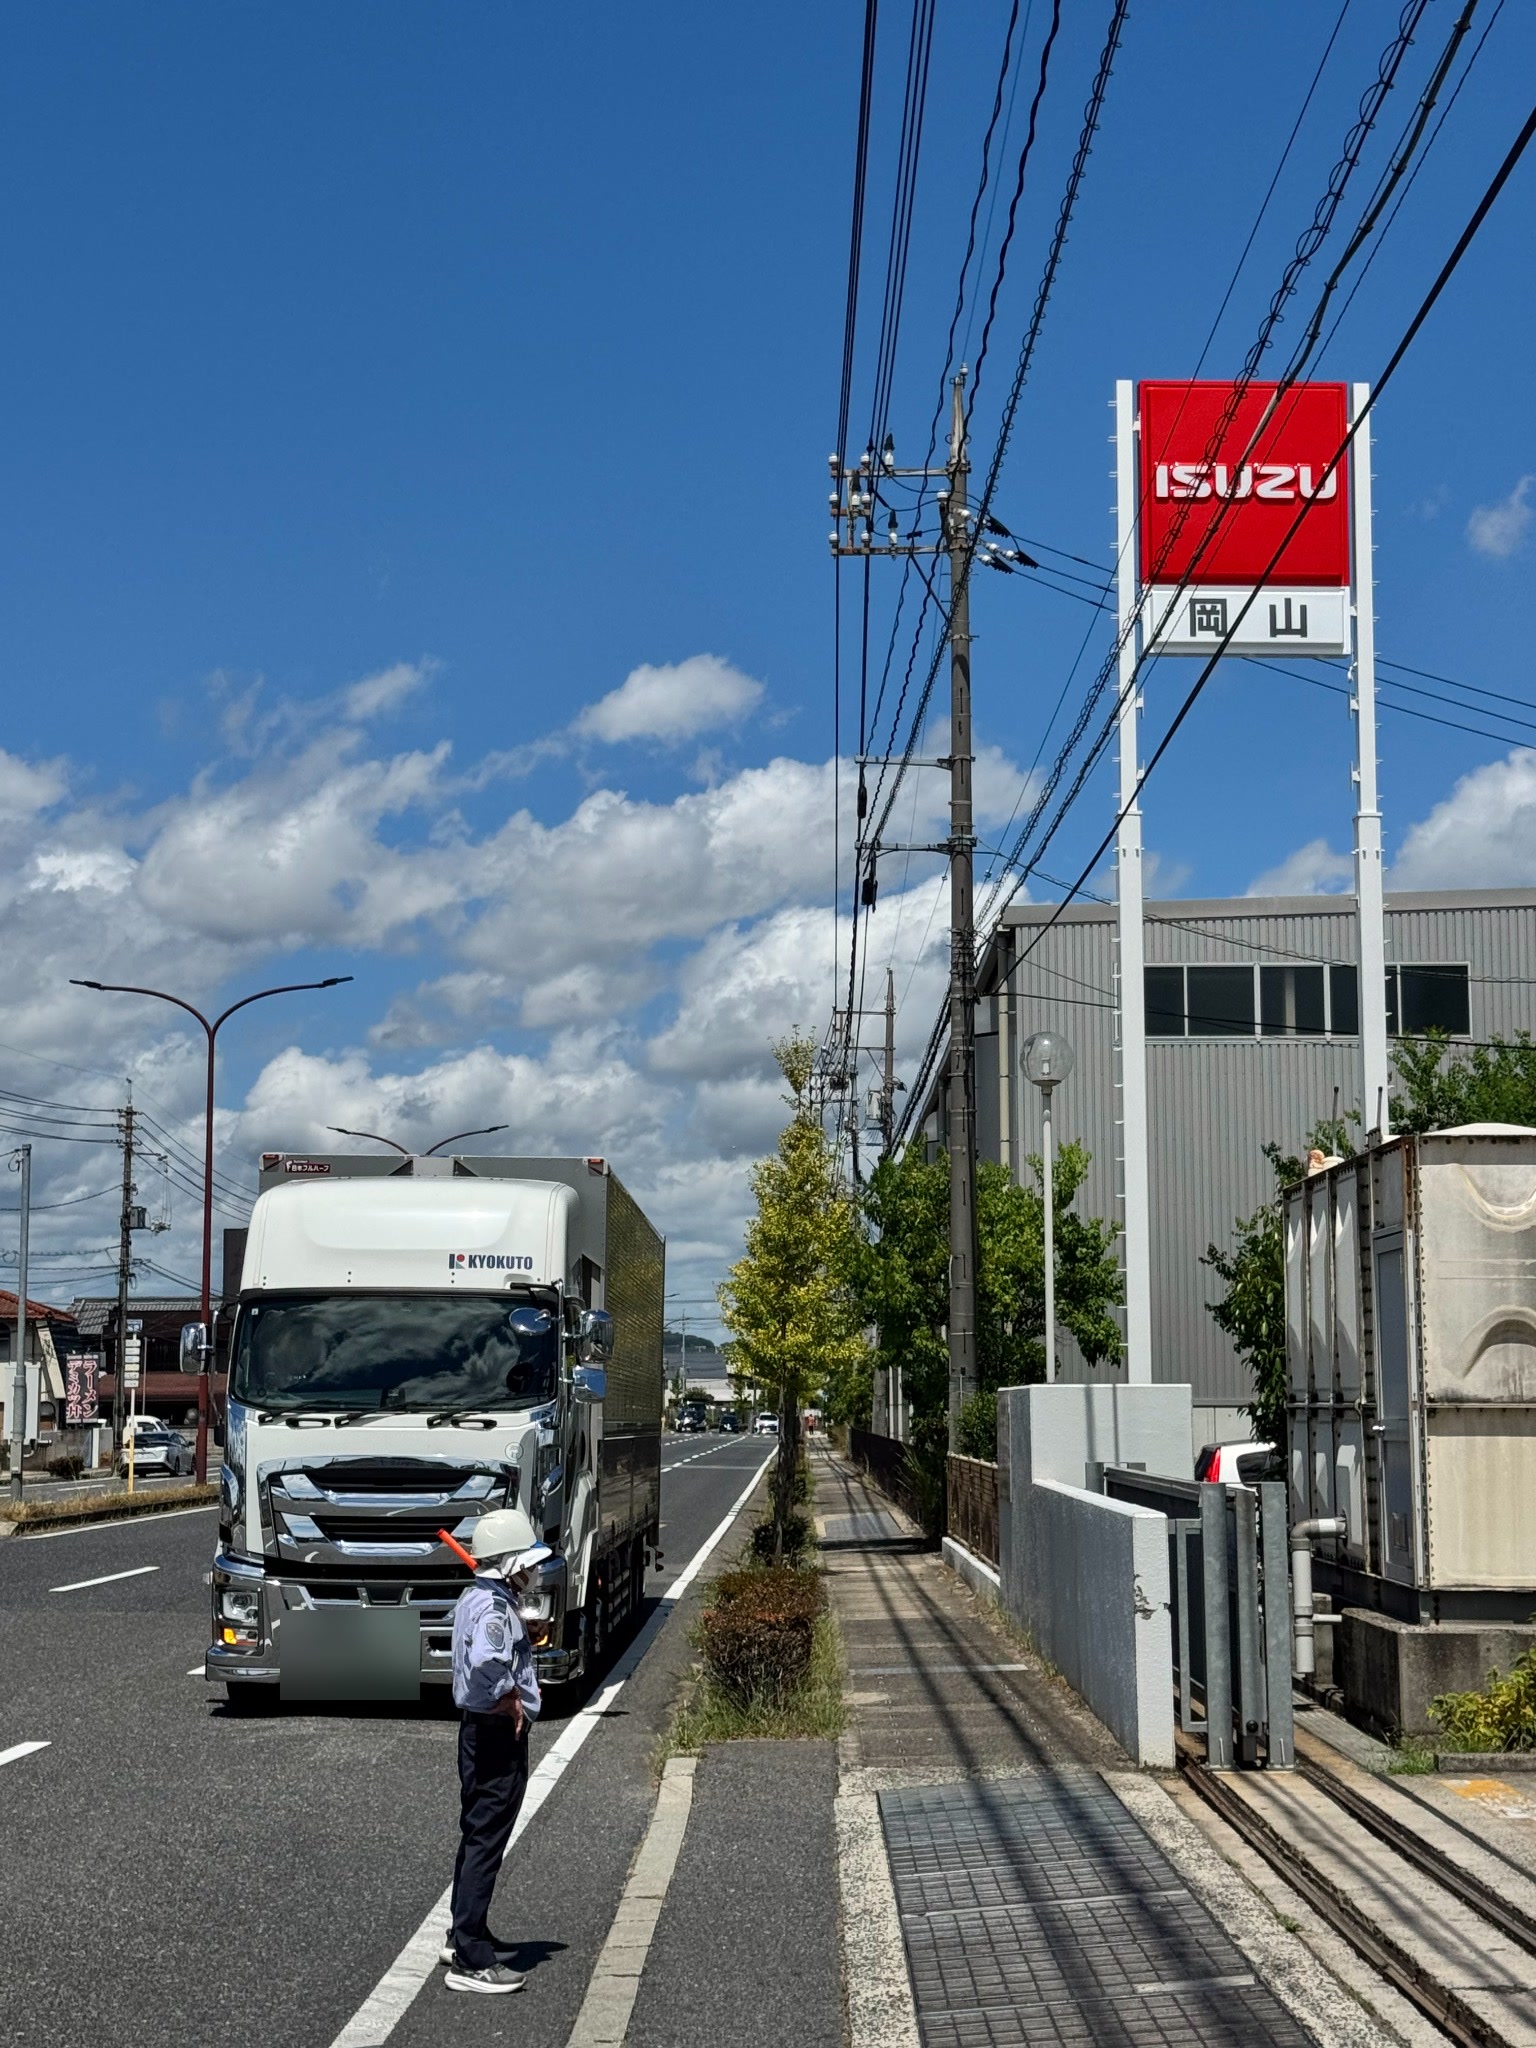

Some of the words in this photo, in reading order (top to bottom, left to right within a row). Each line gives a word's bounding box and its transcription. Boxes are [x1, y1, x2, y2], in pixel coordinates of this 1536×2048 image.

[1155, 463, 1337, 499] ISUZU
[1189, 597, 1307, 638] 岡山
[468, 1255, 533, 1269] KYOKUTO
[82, 1360, 98, 1418] ラーメン
